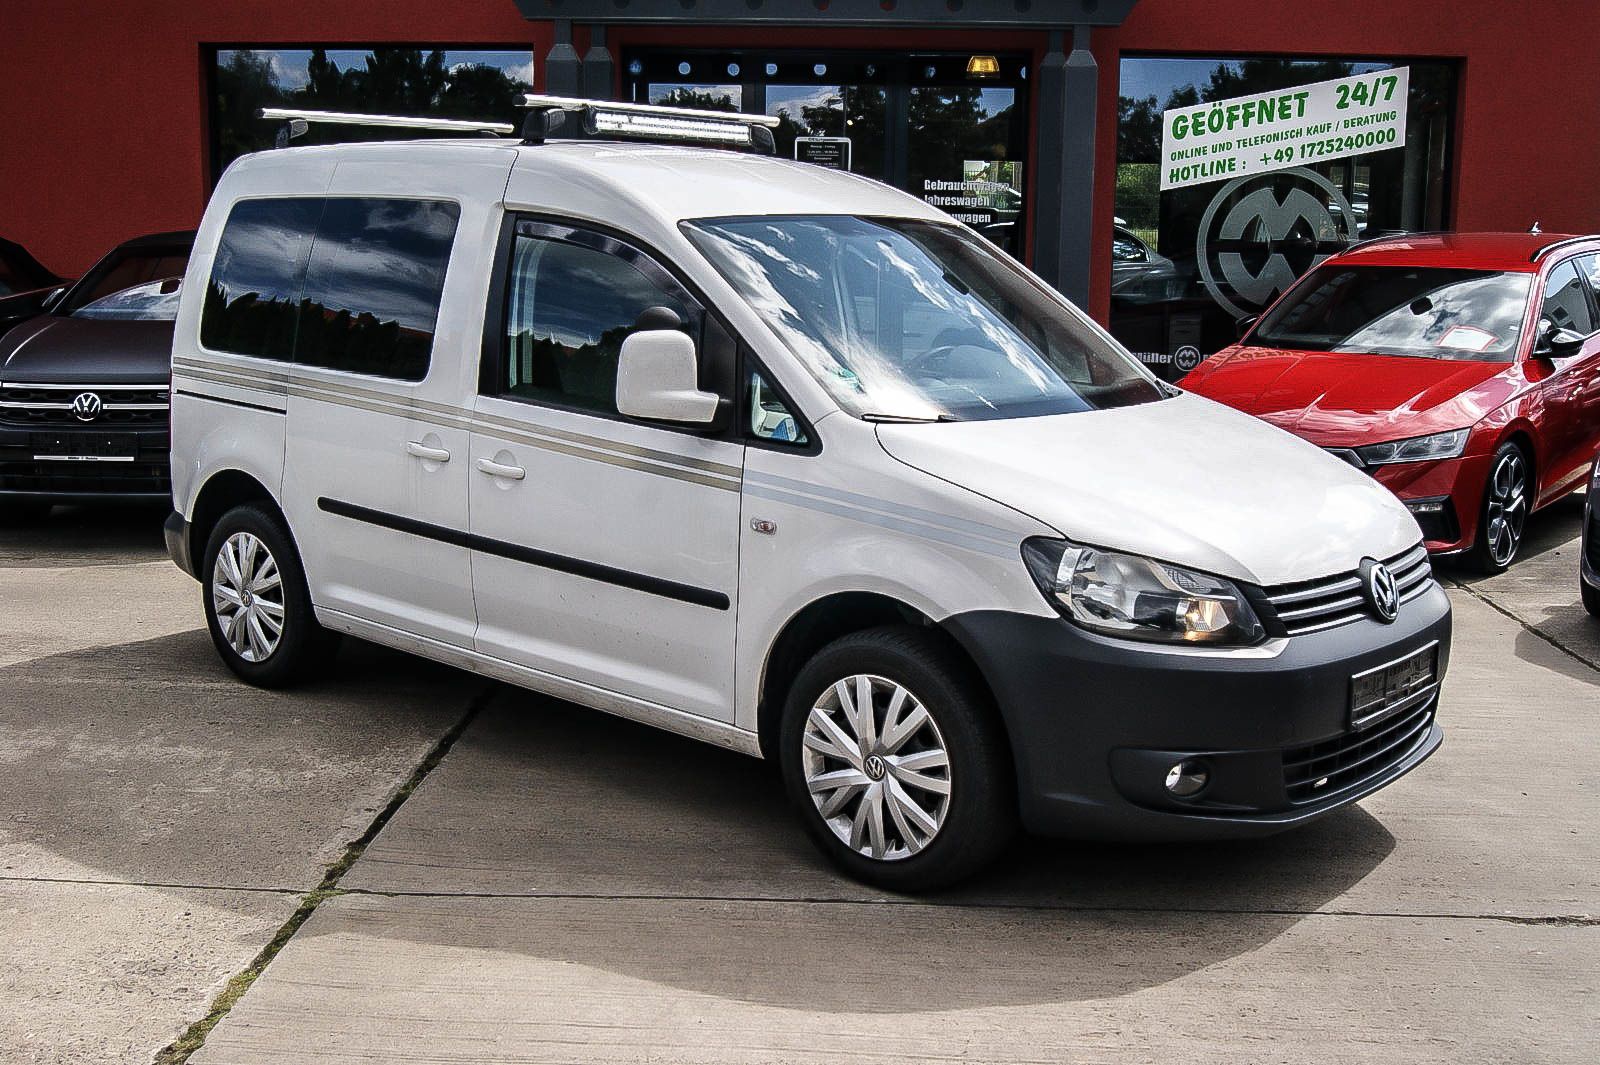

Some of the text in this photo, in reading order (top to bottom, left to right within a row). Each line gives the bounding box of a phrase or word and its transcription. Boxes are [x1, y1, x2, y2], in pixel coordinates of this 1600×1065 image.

[1171, 75, 1398, 140] GEÖFFNET 24/7
[1169, 157, 1236, 183] HOTLINE
[1259, 146, 1294, 166] +49
[1299, 127, 1396, 159] 1725240000
[1170, 145, 1208, 162] ONLINE
[1211, 141, 1233, 154] UND
[1236, 127, 1303, 148] TELEFONISCH
[1306, 122, 1333, 137] KAUF
[1343, 110, 1397, 129] BERATUNG
